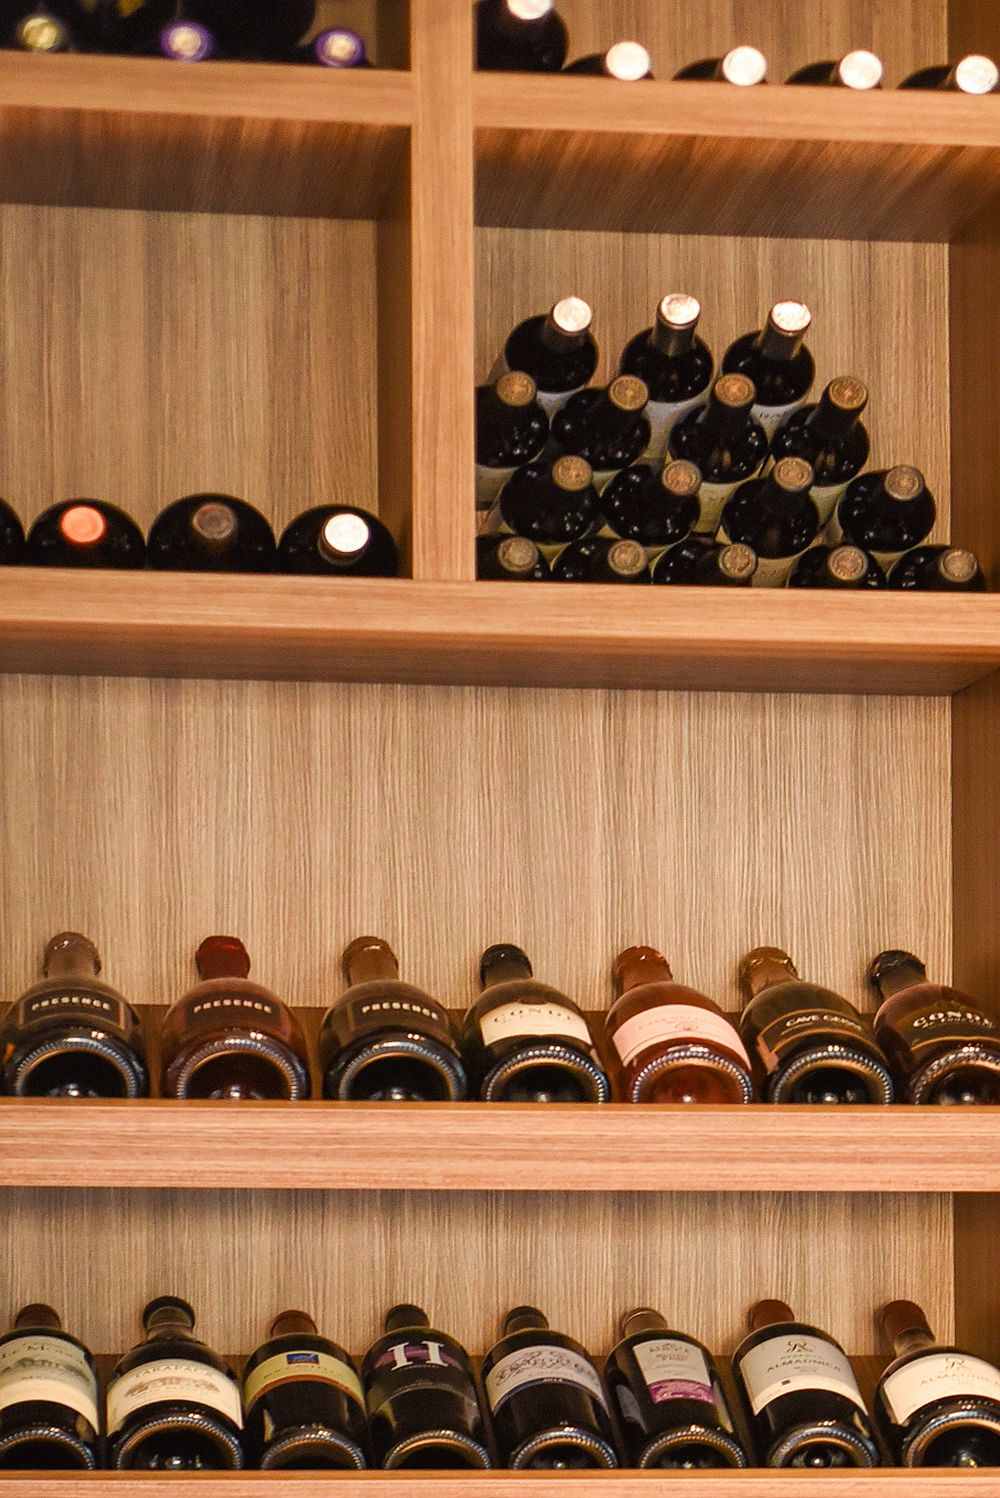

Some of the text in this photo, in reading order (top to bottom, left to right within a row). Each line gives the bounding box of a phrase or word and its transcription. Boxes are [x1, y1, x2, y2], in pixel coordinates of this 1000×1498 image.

[31, 996, 110, 1012] PRESENCE
[193, 999, 272, 1014] PRESENCE
[361, 1002, 438, 1020] PRESENCE
